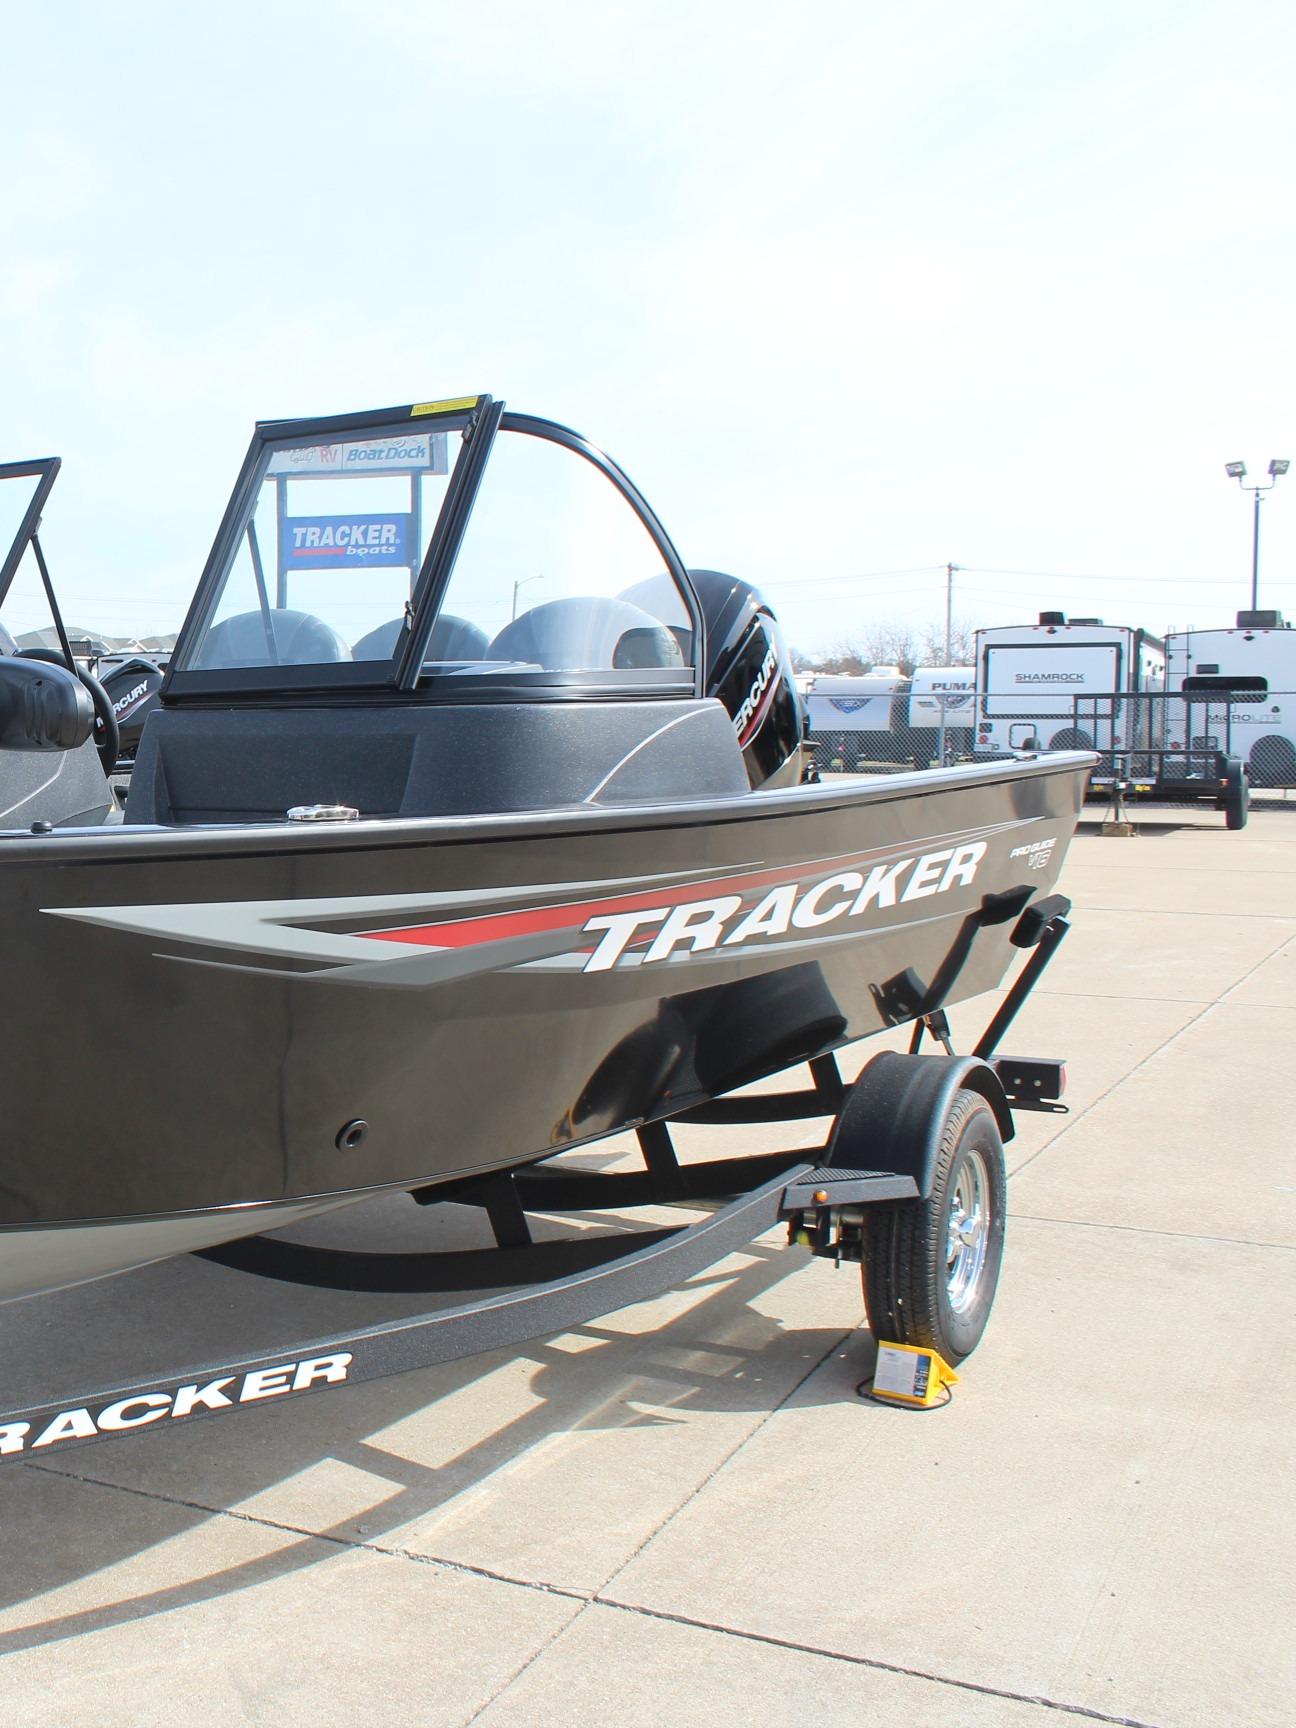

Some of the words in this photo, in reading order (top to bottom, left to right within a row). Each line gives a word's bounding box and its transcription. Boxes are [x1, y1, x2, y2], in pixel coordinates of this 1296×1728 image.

[319, 447, 338, 463] RV
[292, 524, 397, 547] TRACKER
[346, 544, 396, 556] boats
[1015, 673, 1084, 681] SHAMROCK
[931, 682, 976, 690] PUMA
[582, 841, 988, 974] TRACKER
